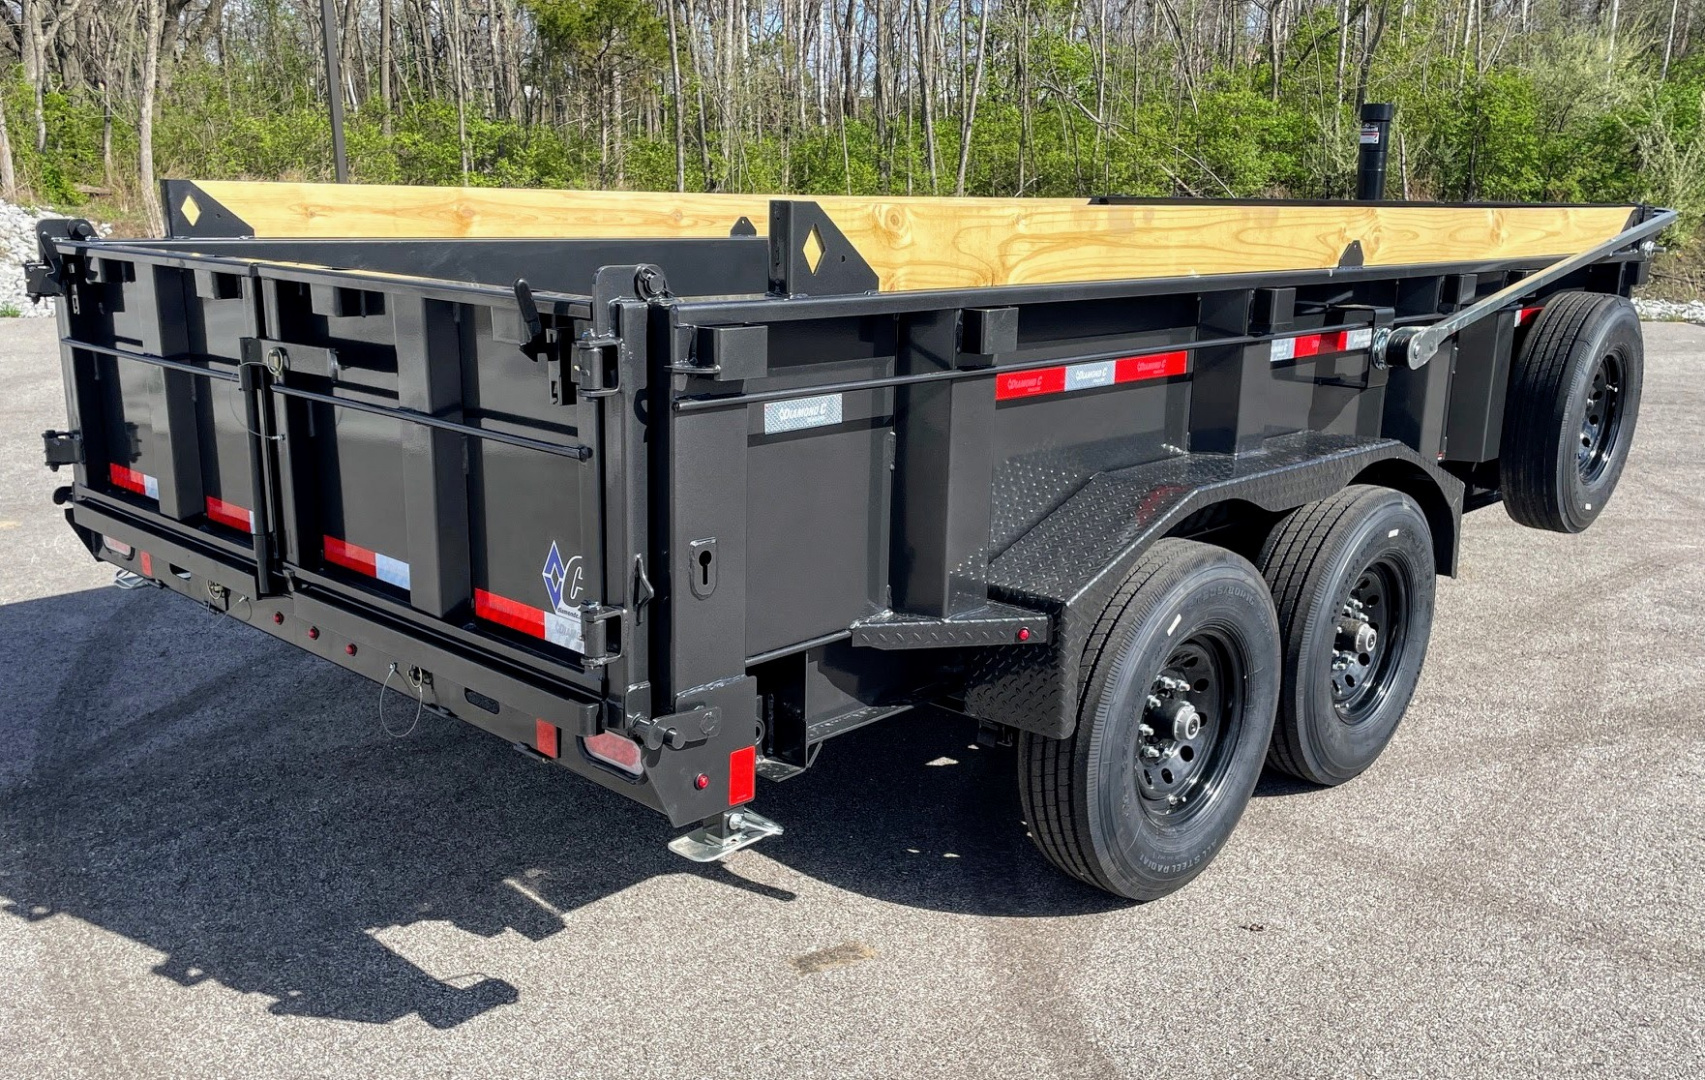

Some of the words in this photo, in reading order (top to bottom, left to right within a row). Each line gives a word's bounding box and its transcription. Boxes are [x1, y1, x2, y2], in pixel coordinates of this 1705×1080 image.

[783, 405, 820, 419] DIAMOND
[820, 402, 827, 415] C
[1172, 854, 1201, 873] STEEL
